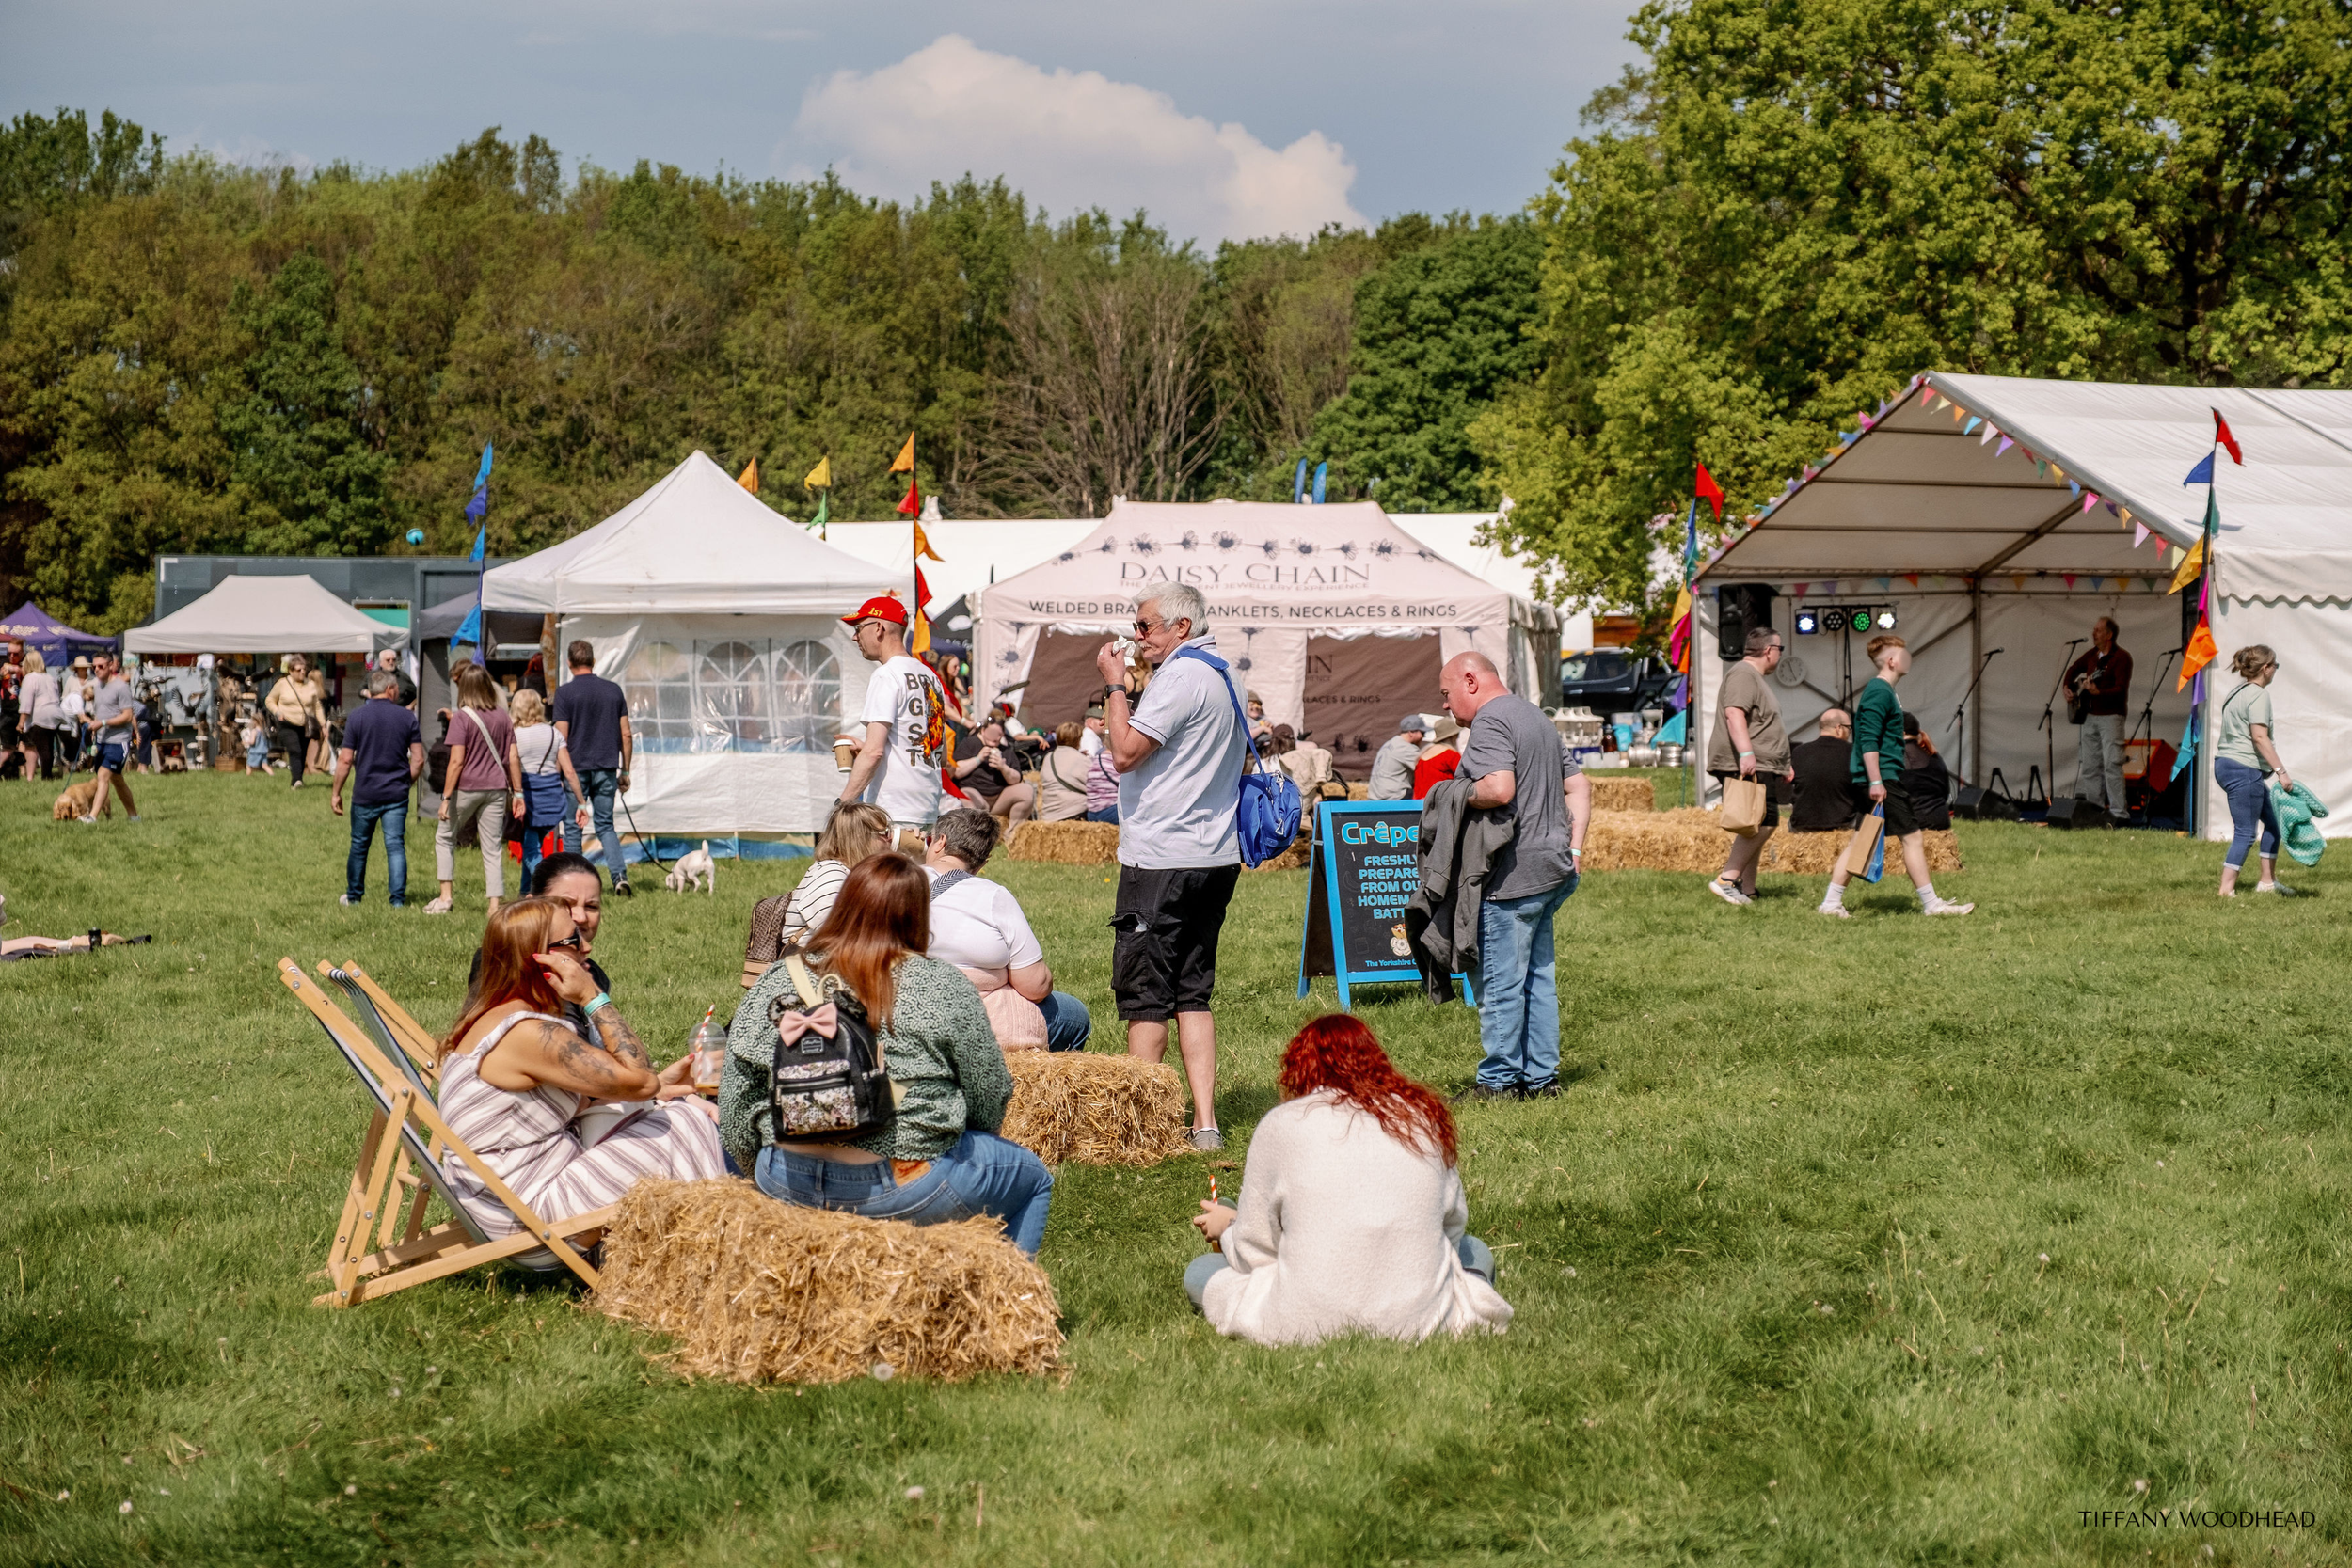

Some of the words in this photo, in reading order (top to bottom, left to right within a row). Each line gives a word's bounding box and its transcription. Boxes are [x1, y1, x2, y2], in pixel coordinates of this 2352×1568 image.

[1120, 562, 1228, 583] DAISY
[1246, 562, 1371, 584] CHAIN
[1120, 579, 1140, 588] THE
[1295, 582, 1370, 592] EXPERIENCE
[867, 607, 884, 617] 1ST
[1029, 600, 1099, 615] WELDED
[1206, 605, 1284, 619] ANKLETS,
[1290, 605, 1386, 618] NECKLACES
[1391, 605, 1402, 617] &
[1406, 604, 1457, 617] RINGS
[1304, 695, 1338, 704] LACES
[1342, 821, 1419, 848] Crêpe
[1359, 867, 1419, 880] PREPARE
[1360, 881, 1400, 894] FROM
[1402, 880, 1421, 893] OU
[1358, 894, 1410, 907] HOMEM
[1374, 908, 1405, 920] BATT
[1379, 958, 1411, 967] Yorkshire
